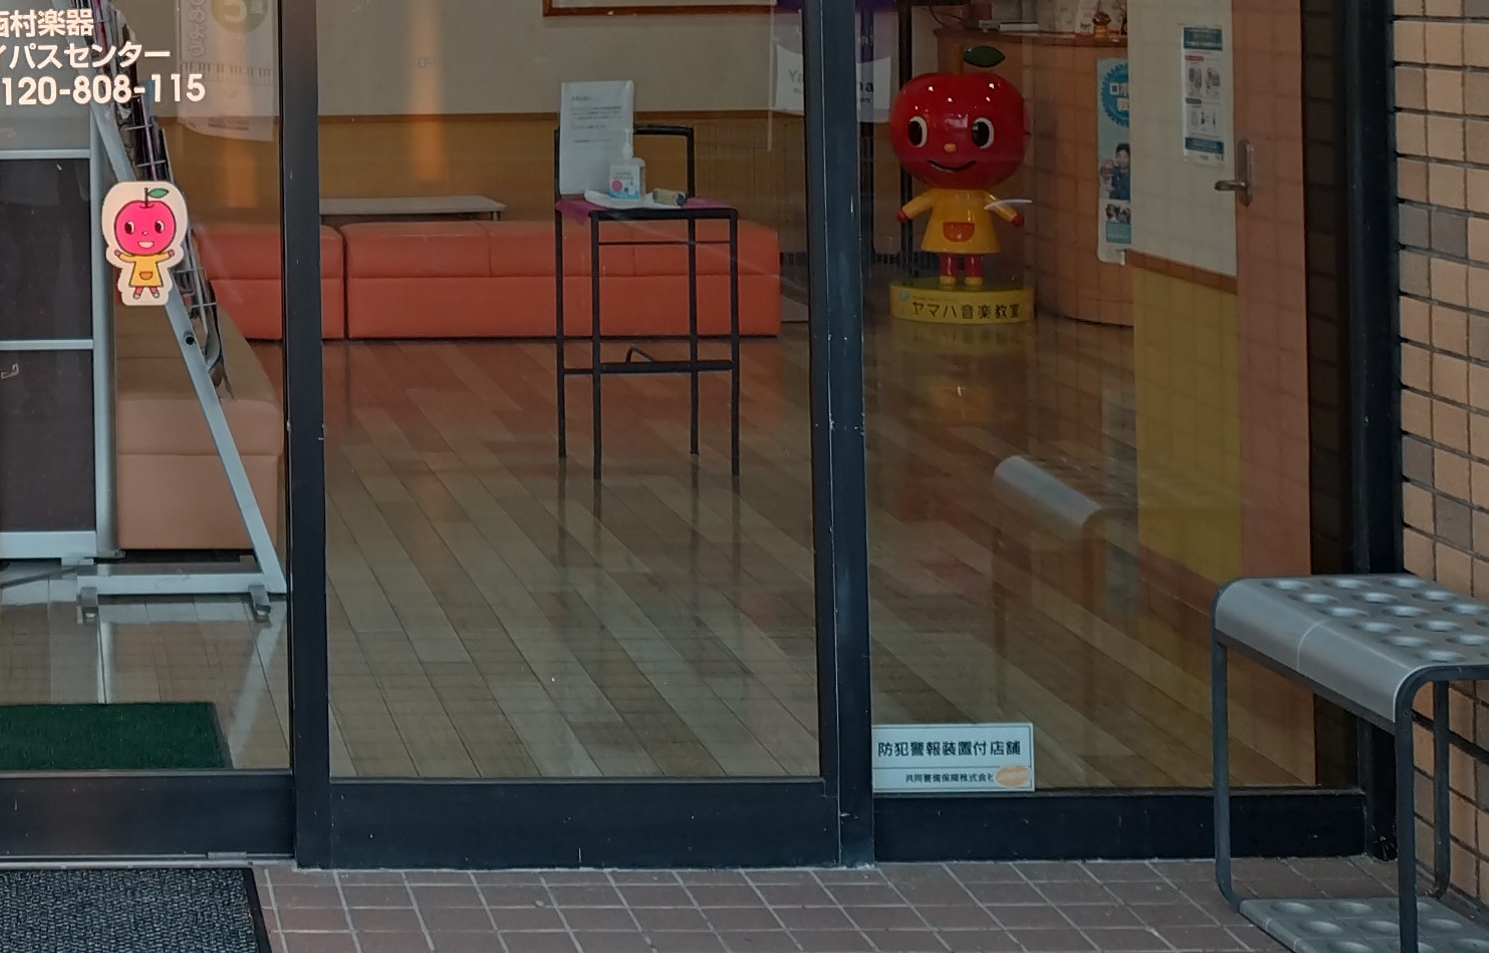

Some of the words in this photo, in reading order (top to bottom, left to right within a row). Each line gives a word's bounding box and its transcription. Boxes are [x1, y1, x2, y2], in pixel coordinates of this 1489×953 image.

[912, 301, 1022, 320] ヤマハ音楽教室
[877, 740, 1022, 758] 防犯警報装置付店舗
